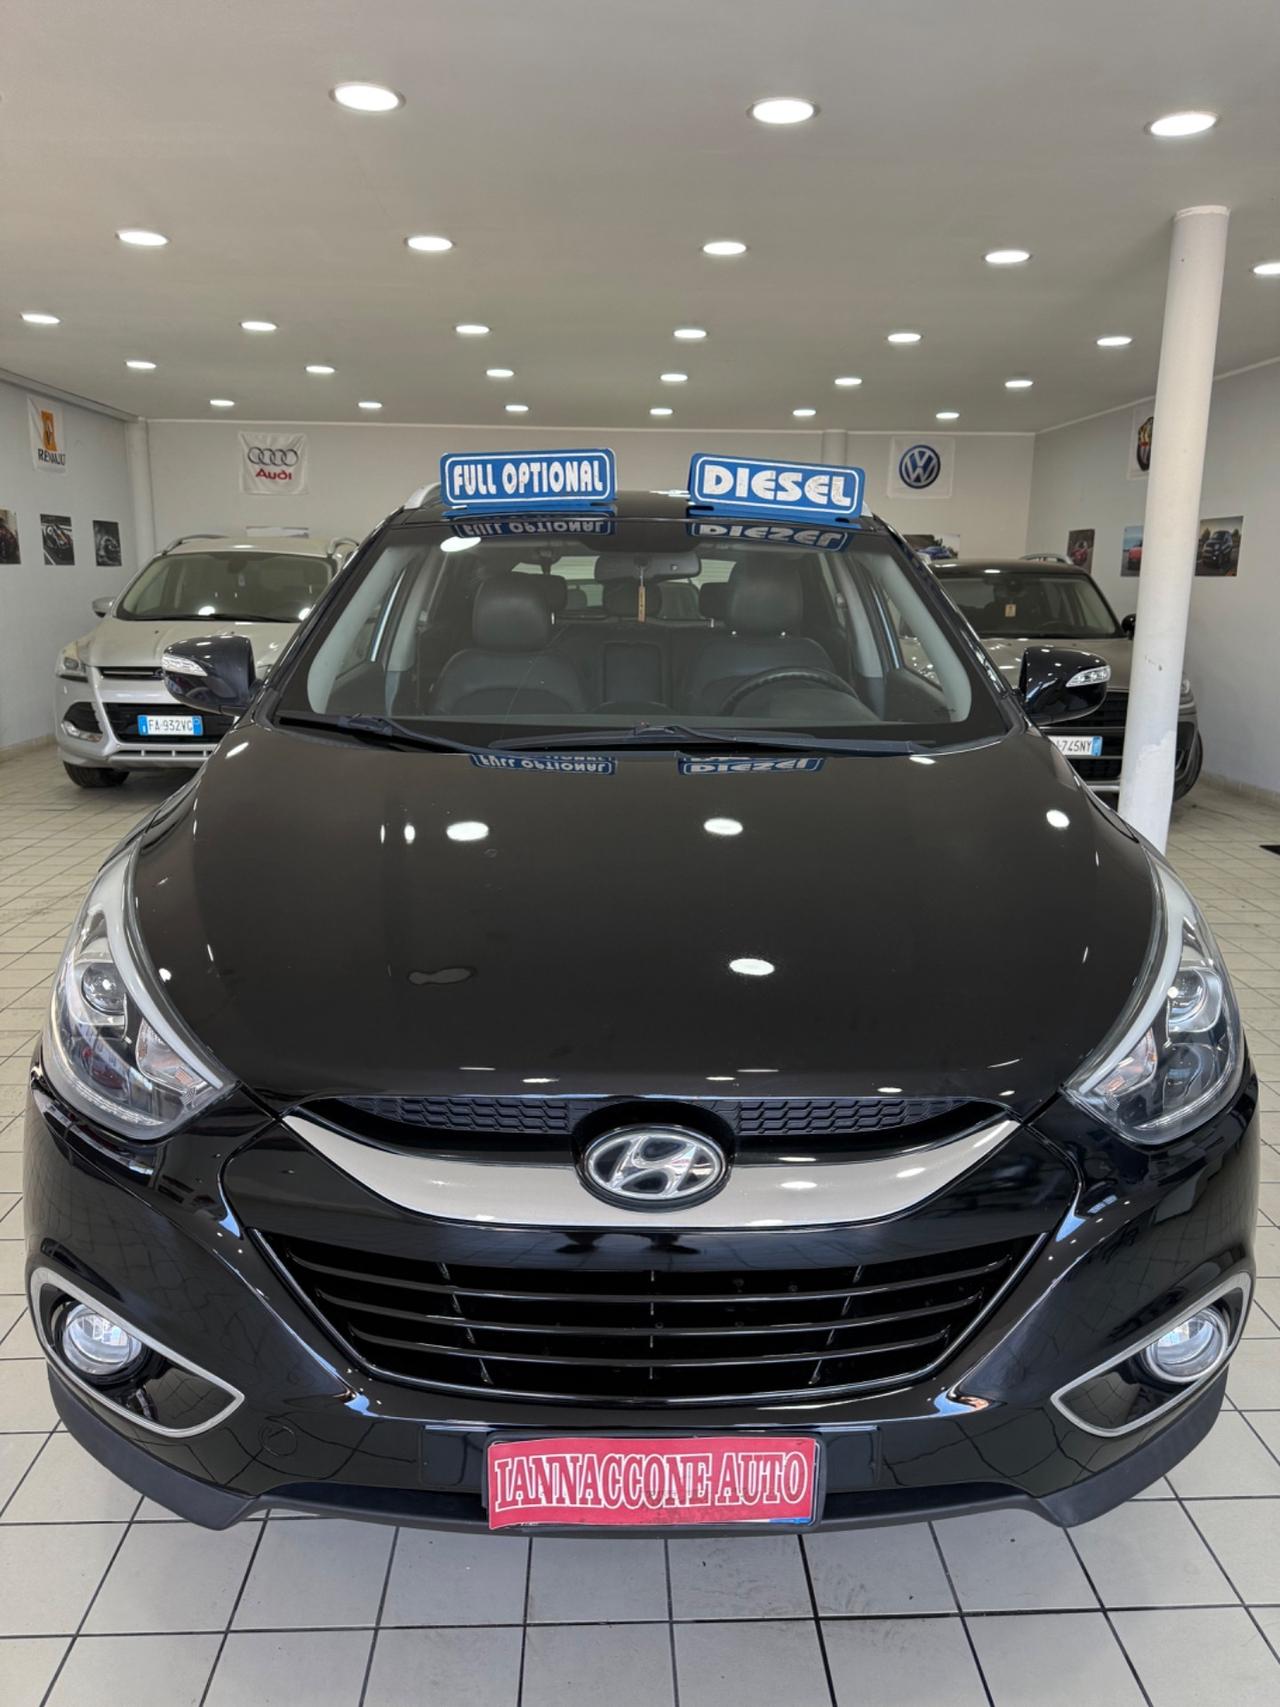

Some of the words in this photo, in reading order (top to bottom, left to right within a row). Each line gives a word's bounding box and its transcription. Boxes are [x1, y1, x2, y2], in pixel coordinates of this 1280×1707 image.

[255, 468, 292, 480] Audi
[453, 463, 496, 496] FULL
[501, 460, 603, 495] OPTIONAL
[702, 464, 852, 507] DIESEL
[494, 1452, 713, 1512] IANNACCONE
[714, 1451, 809, 1506] AUTO
